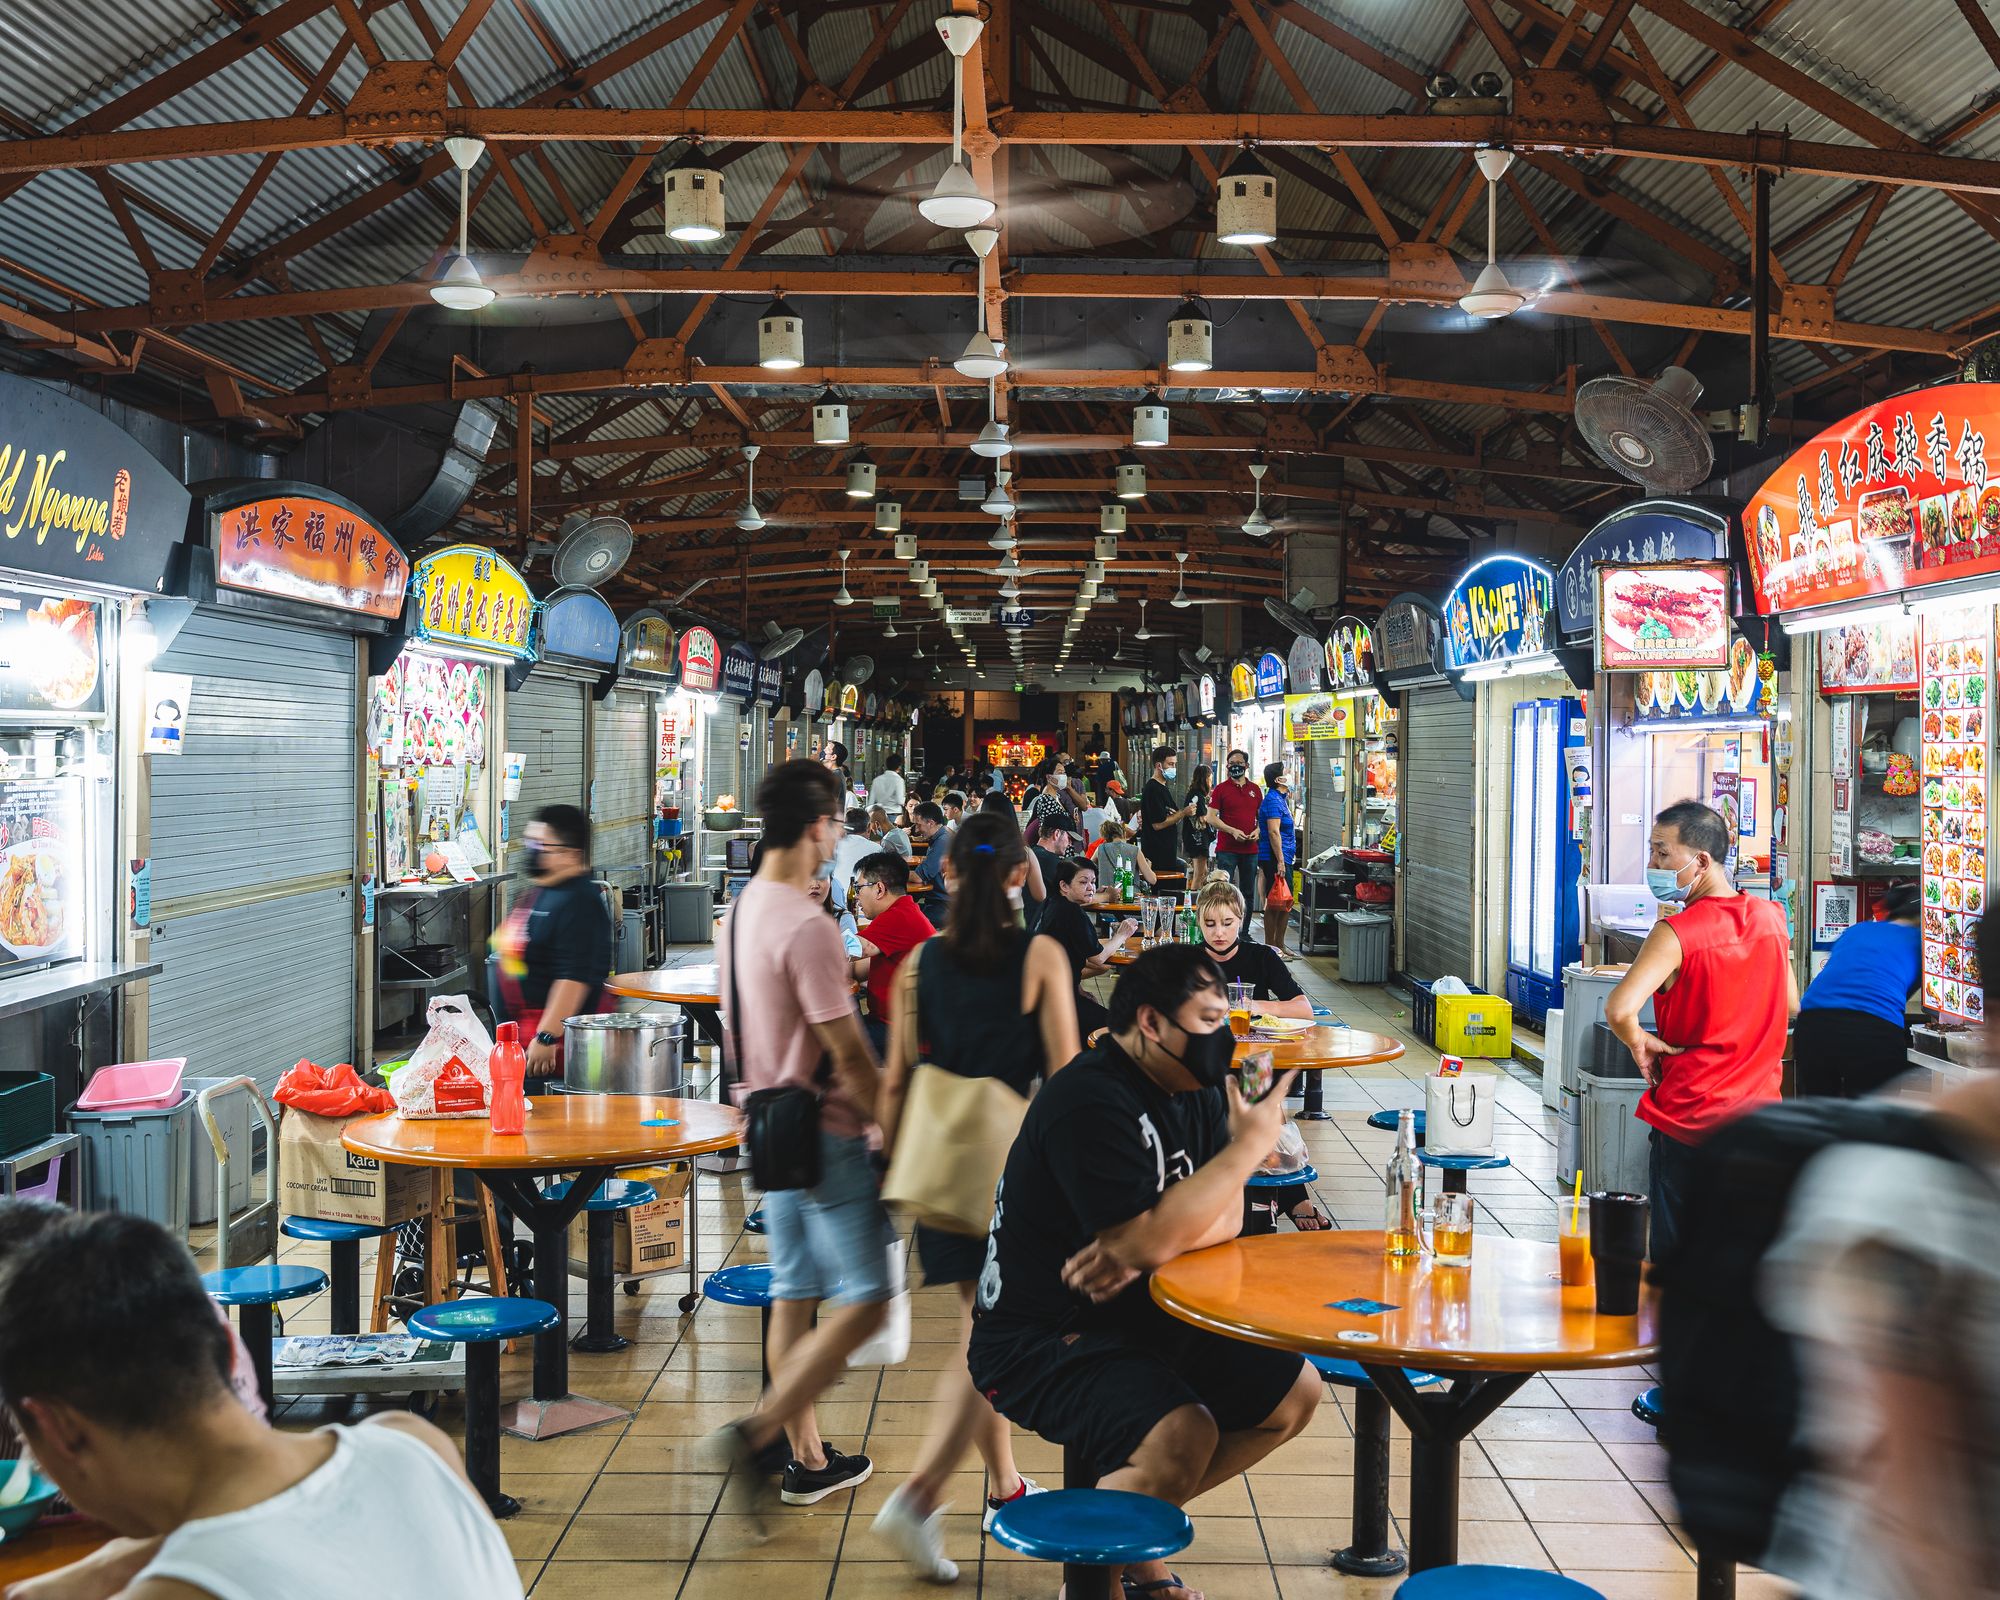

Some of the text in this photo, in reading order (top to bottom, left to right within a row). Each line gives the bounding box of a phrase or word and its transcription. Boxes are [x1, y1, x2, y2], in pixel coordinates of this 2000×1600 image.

[5, 449, 109, 553] Nyonya
[1468, 585, 1490, 640] K3
[1488, 582, 1520, 636] CAFE
[661, 718, 676, 761] 甘蔗汁
[349, 1152, 376, 1168] kara
[286, 1181, 328, 1193] COCONUT CREAM
[316, 1177, 327, 1185] UHT
